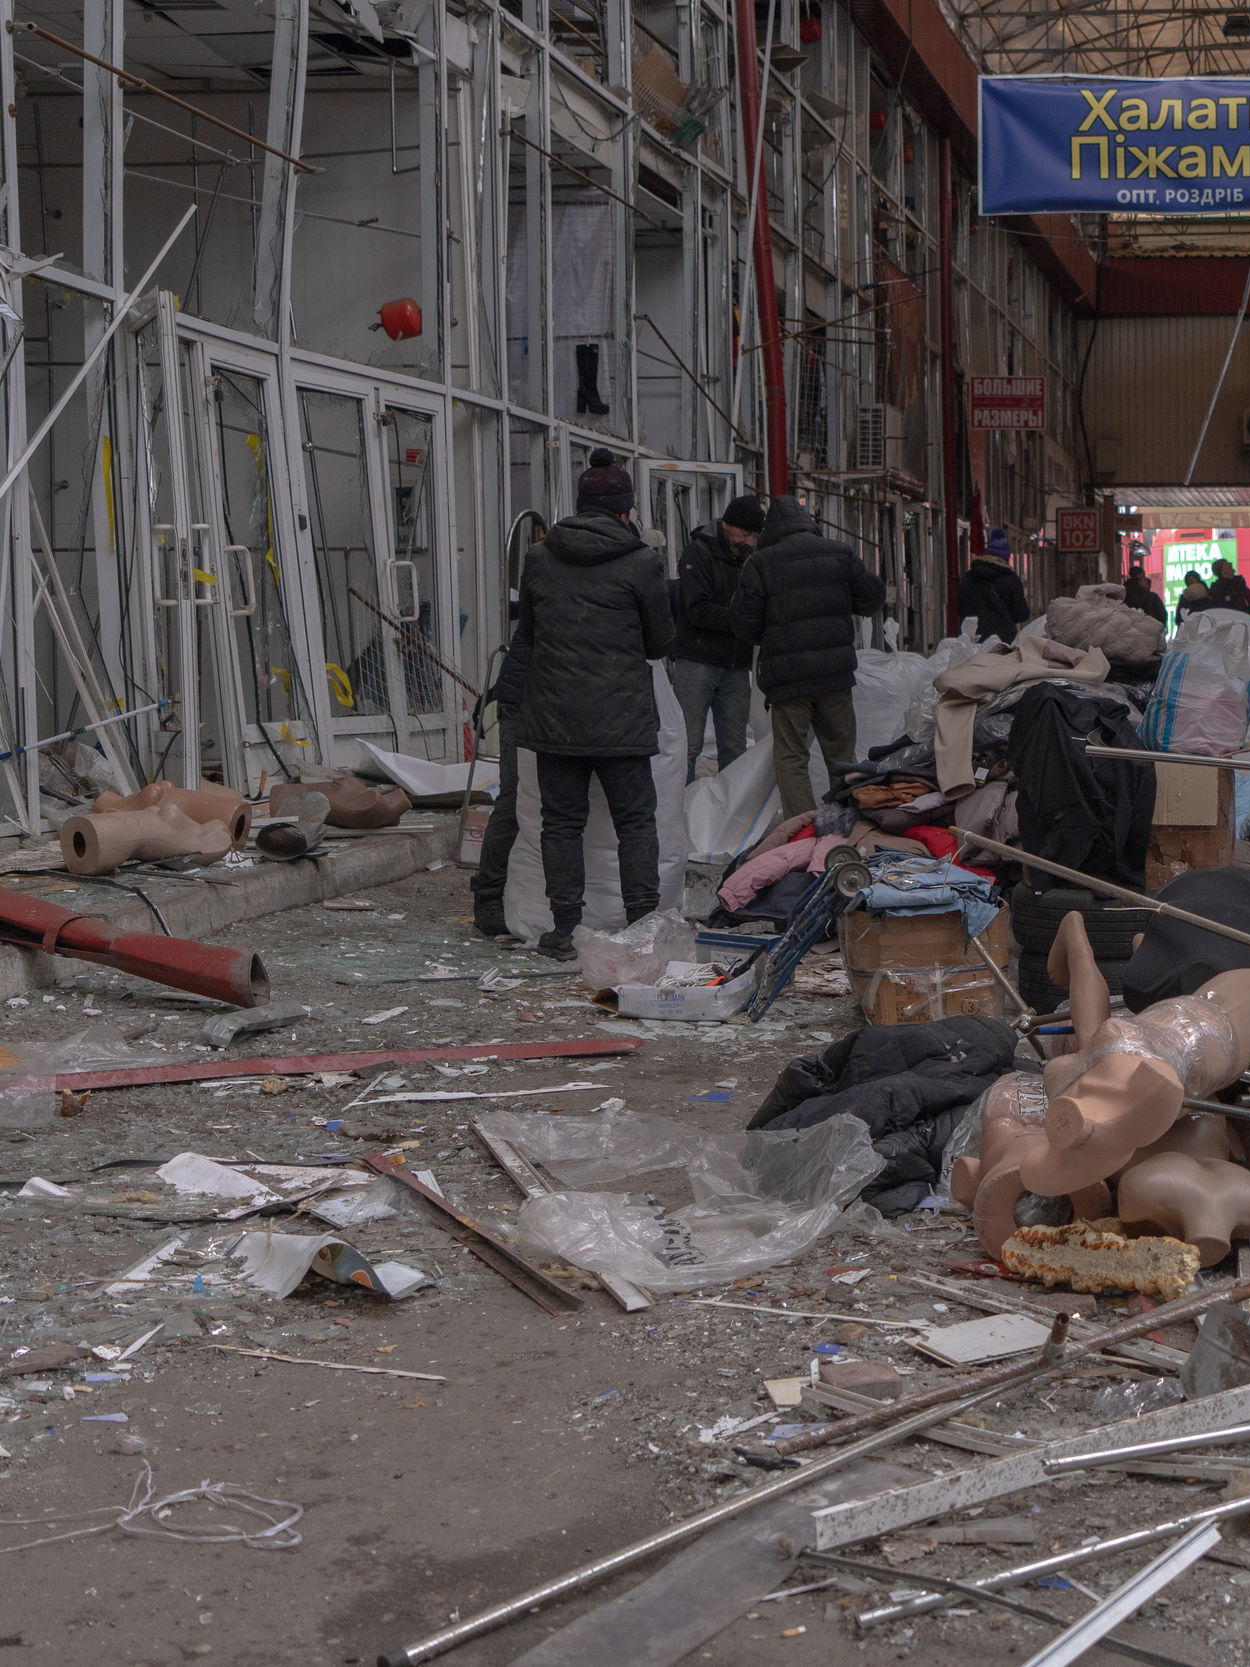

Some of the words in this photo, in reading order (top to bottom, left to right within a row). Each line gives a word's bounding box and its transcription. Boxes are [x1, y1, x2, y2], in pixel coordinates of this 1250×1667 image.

[1117, 189, 1160, 204] ОПТ,
[1165, 188, 1244, 206] РОЗДРІБ
[973, 379, 1042, 396] БОЛЬШИЕ
[973, 410, 1042, 427] РАЗМЕРЫ
[1062, 515, 1095, 530] BKN
[1063, 530, 1095, 547] 102
[656, 993, 686, 1002] FLAGMAN
